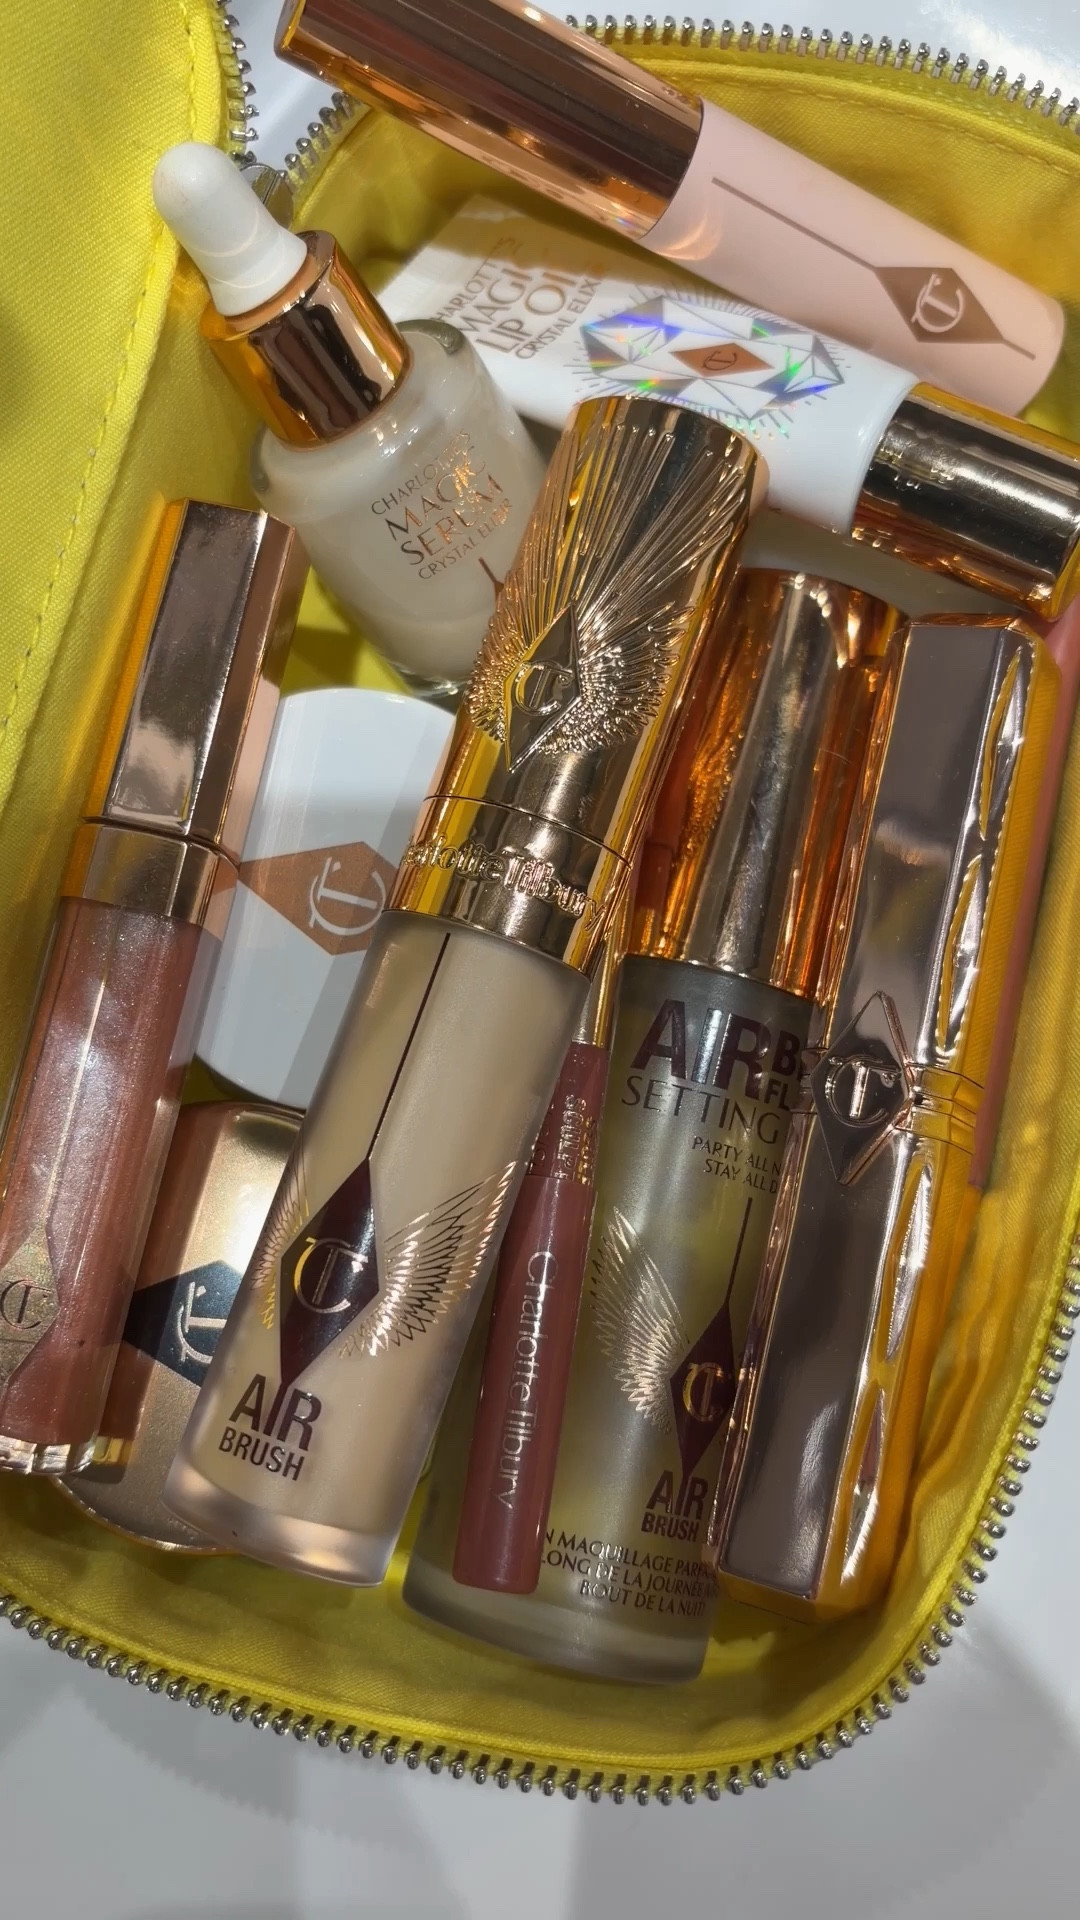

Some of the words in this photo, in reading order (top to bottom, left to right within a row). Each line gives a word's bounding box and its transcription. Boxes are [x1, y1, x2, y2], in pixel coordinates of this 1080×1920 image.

[458, 268, 533, 332] MAGI
[475, 319, 533, 354] LIP
[524, 272, 578, 315] OI
[515, 318, 577, 359] CRYSTAL
[567, 278, 602, 314] ELIX
[385, 445, 486, 541] MAGIC
[400, 474, 503, 566] SERUM
[418, 537, 479, 580] CRYSTAL
[621, 1075, 781, 1144] SETTING
[764, 1078, 791, 1112] FL
[692, 1136, 744, 1162] PARTY
[746, 1154, 769, 1172] ALL
[704, 1158, 741, 1181] STAY
[743, 1174, 767, 1192] ALL
[510, 1250, 559, 1401] Charlotte
[229, 1373, 322, 1451] AIR
[218, 1426, 306, 1481] BRUSH
[490, 1407, 537, 1510] Tilbury
[645, 1470, 709, 1520] AIR
[557, 1531, 673, 1573] MAQUILLAGE
[640, 1511, 700, 1542] BRUSH
[579, 1579, 632, 1605] BOUT
[634, 1591, 657, 1610] DE
[658, 1597, 675, 1615] LA
[677, 1600, 706, 1617] NUIT
[595, 1562, 620, 1582] DE
[622, 1568, 643, 1588] LA
